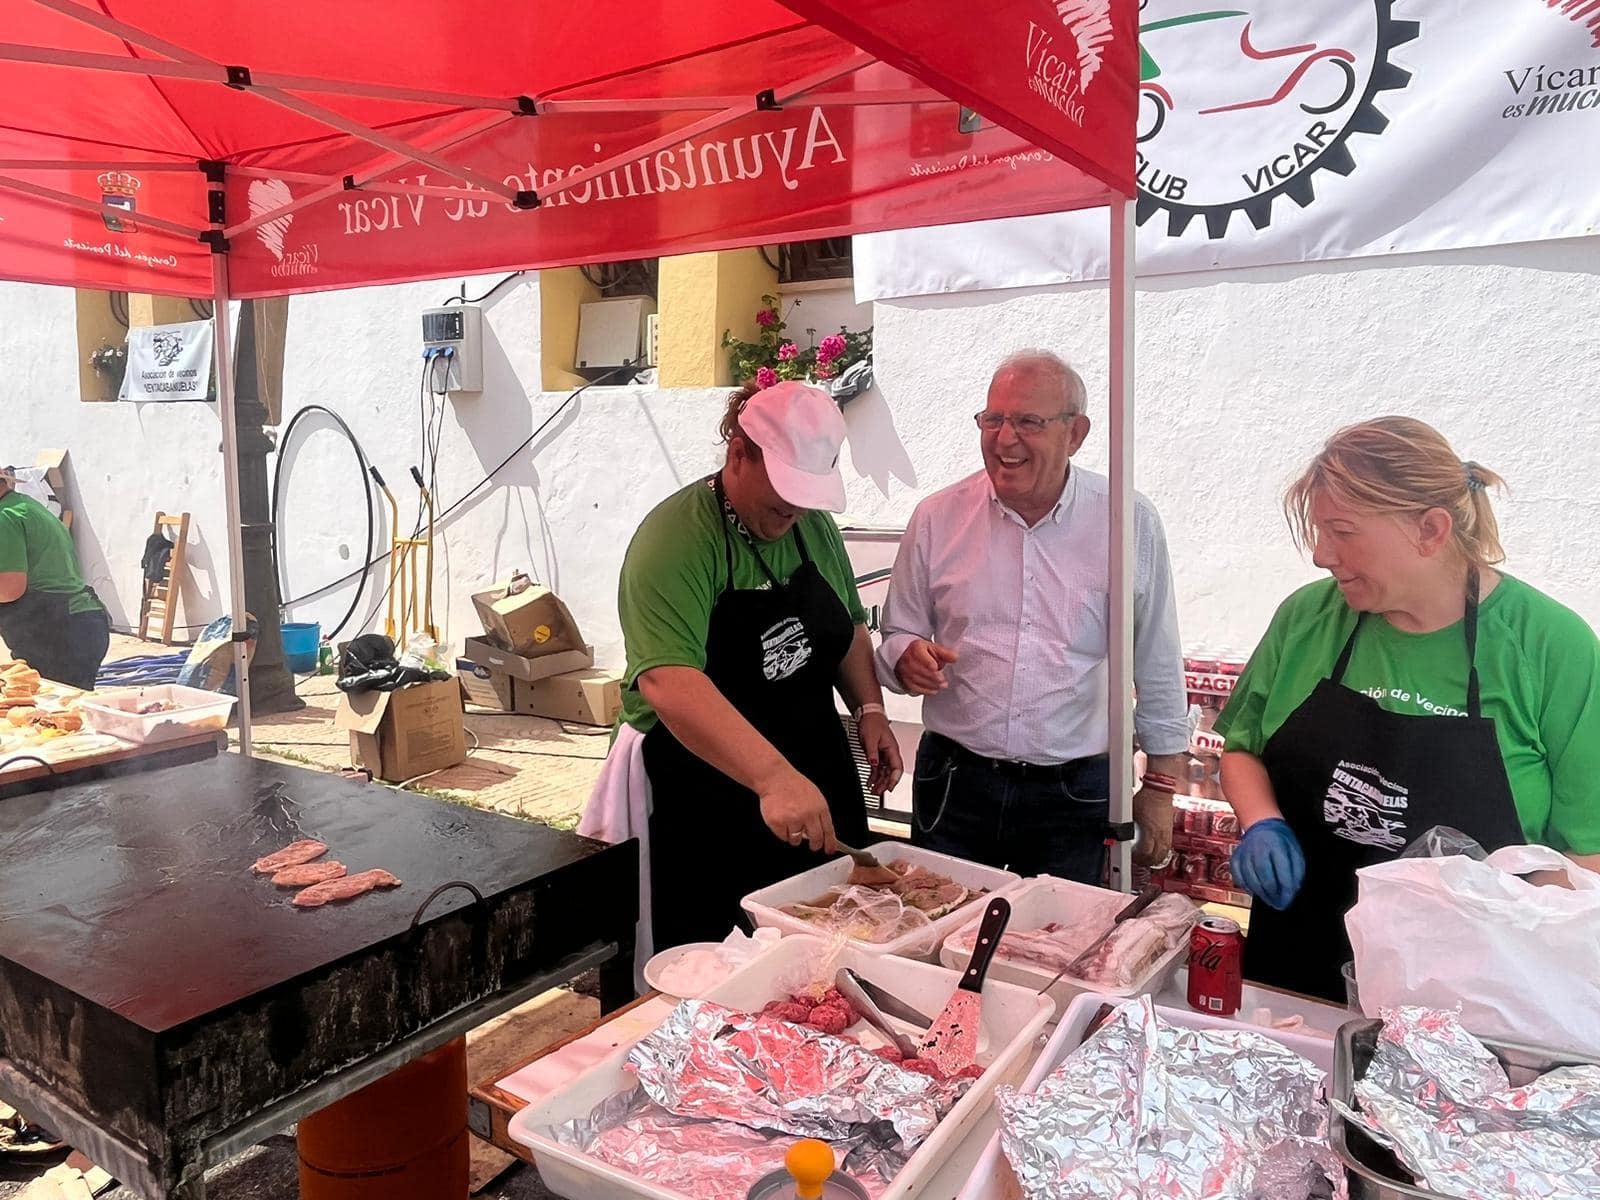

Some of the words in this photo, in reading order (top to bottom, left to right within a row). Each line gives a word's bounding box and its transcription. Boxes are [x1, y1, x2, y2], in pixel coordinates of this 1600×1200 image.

[1026, 20, 1076, 93] Vícar
[1503, 64, 1600, 95] Vícar
[1502, 103, 1526, 118] es
[1525, 88, 1600, 117] muc
[1241, 120, 1338, 193] VICAR
[1390, 688, 1411, 702] de
